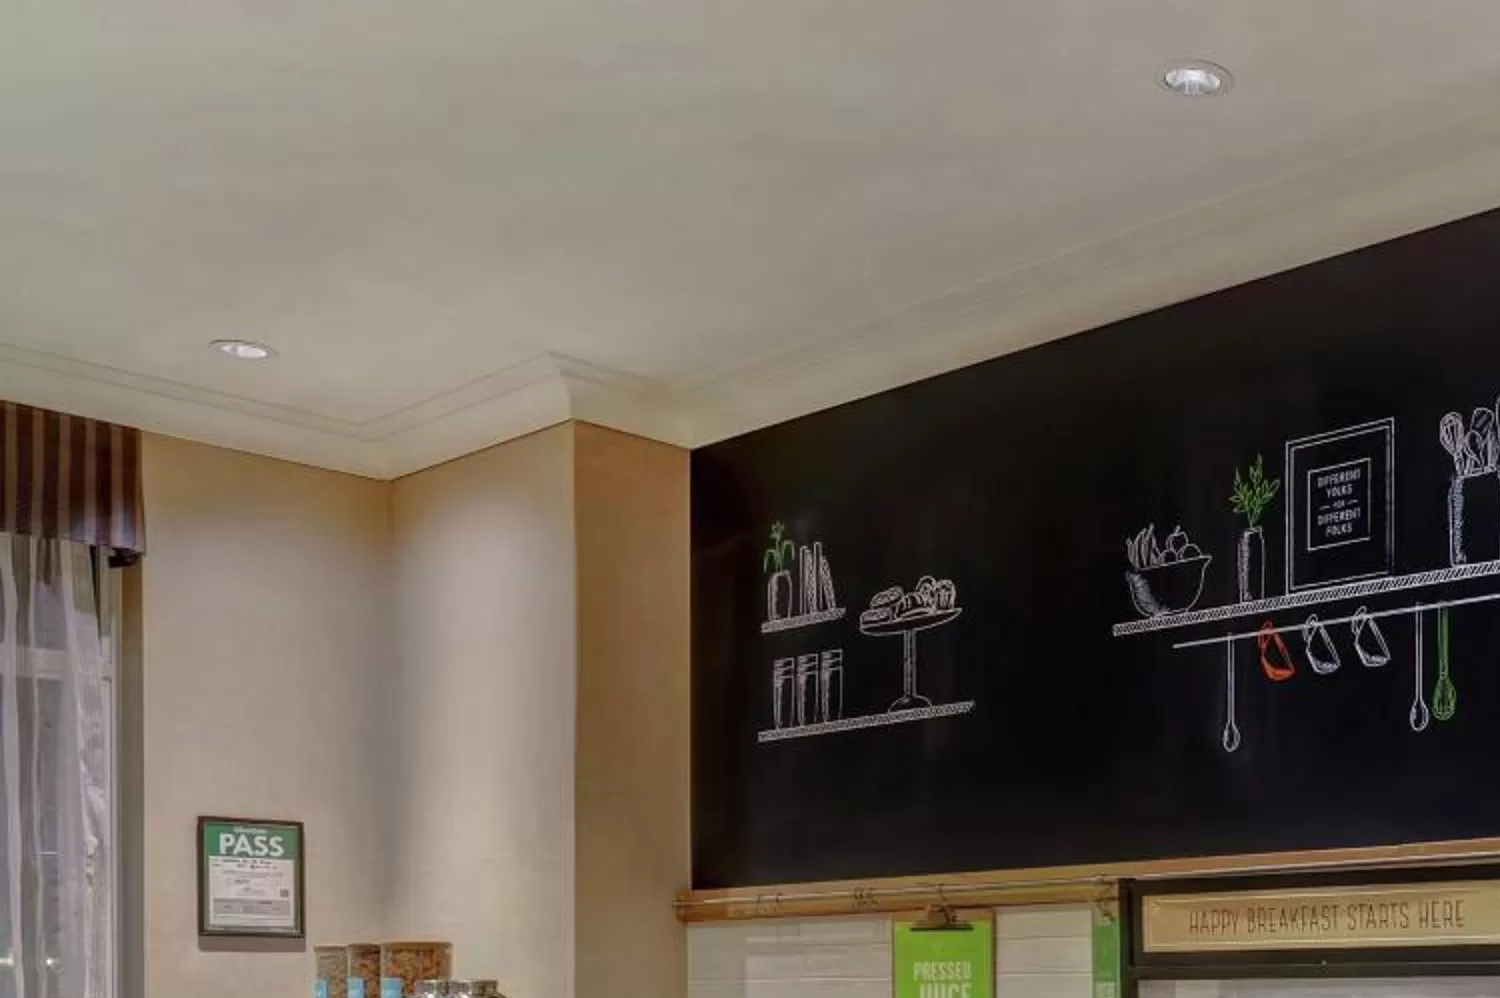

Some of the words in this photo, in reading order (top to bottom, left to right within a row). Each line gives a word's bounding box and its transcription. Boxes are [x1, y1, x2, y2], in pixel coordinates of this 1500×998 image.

[1317, 468, 1361, 488] DIFFERENT
[1317, 508, 1361, 526] DIFFERENT
[220, 833, 284, 857] PASS
[1188, 909, 1239, 934] HAPPY
[1247, 904, 1339, 933] BREAKFAST
[1347, 902, 1409, 931] STARTS
[1419, 900, 1465, 929] HERE
[913, 961, 972, 982] PRESSED
